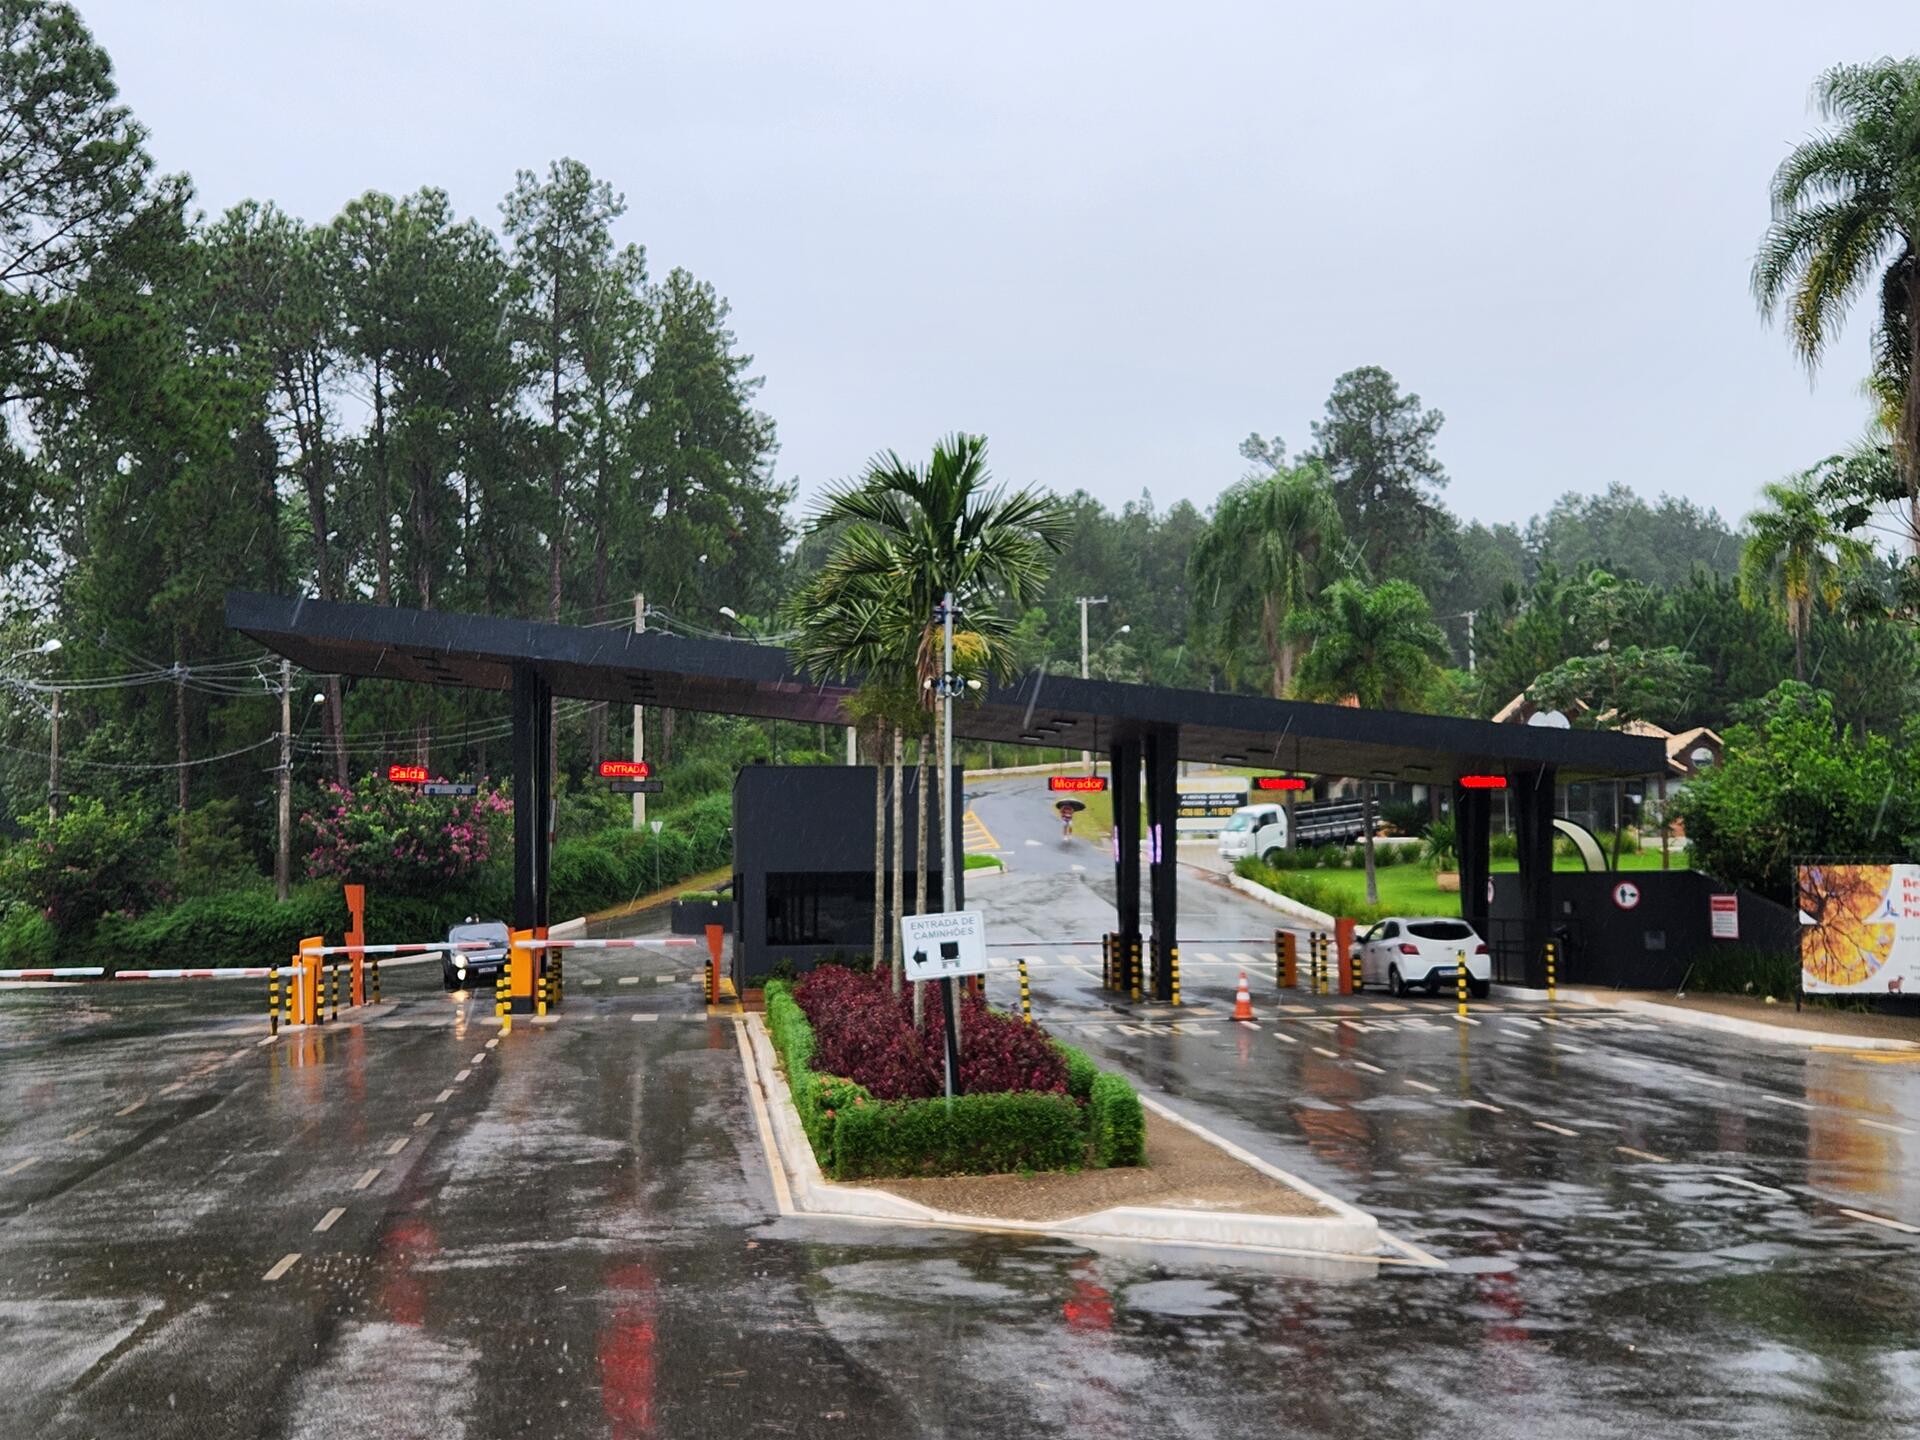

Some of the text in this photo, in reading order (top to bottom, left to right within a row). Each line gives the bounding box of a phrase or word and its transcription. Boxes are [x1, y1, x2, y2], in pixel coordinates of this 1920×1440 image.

[602, 764, 647, 774] ENTRADA
[1054, 777, 1102, 789] Morador
[910, 916, 975, 930] ENTRADA DE
[912, 926, 974, 940] CAMINHÕES
